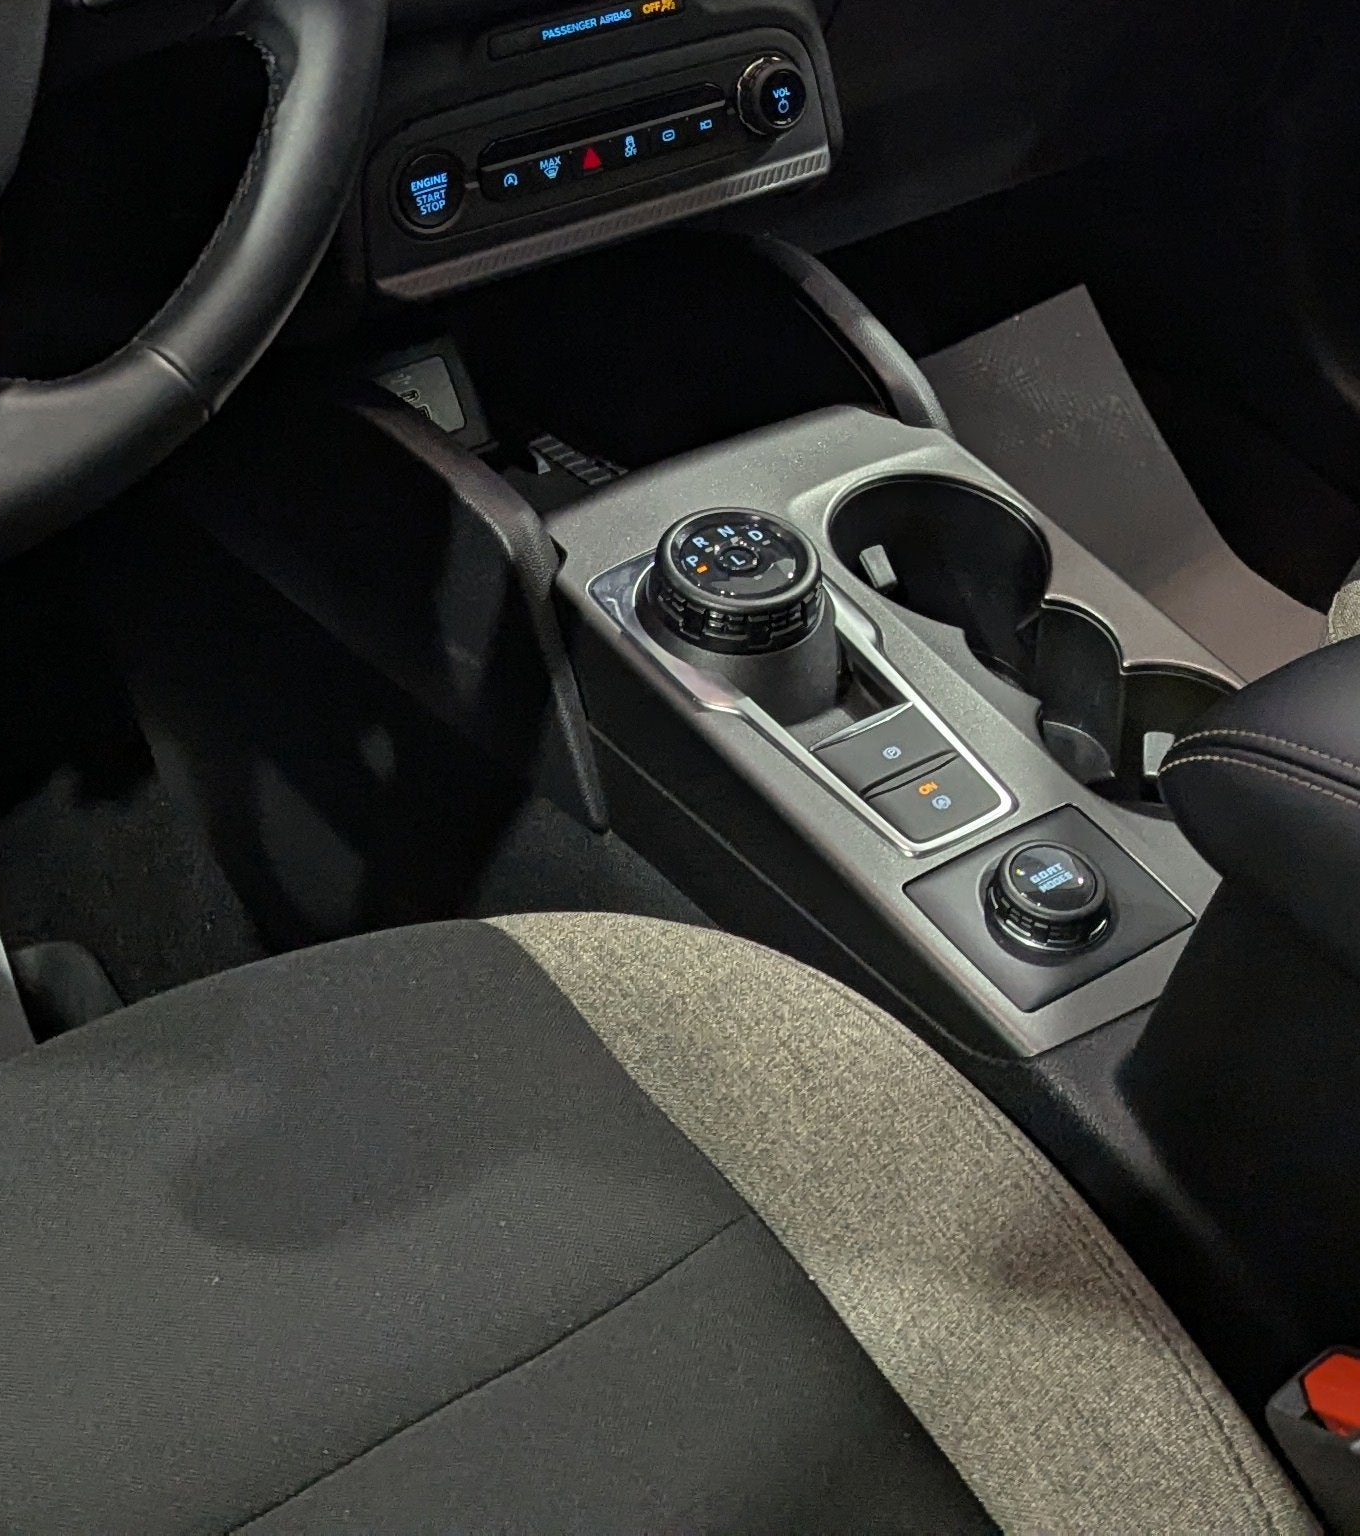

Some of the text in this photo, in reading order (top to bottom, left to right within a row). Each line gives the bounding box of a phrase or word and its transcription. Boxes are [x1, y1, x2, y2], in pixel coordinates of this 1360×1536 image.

[542, 1, 660, 40] PASSENGER AIRBAG OFF
[772, 86, 791, 99] VOL
[539, 155, 562, 170] MAX
[411, 172, 448, 192] ENGINE
[415, 189, 447, 207] START
[420, 199, 446, 215] STOP
[716, 525, 735, 538] N
[747, 530, 763, 541] D
[692, 536, 710, 548] R
[685, 555, 699, 567] P
[730, 555, 746, 566] L
